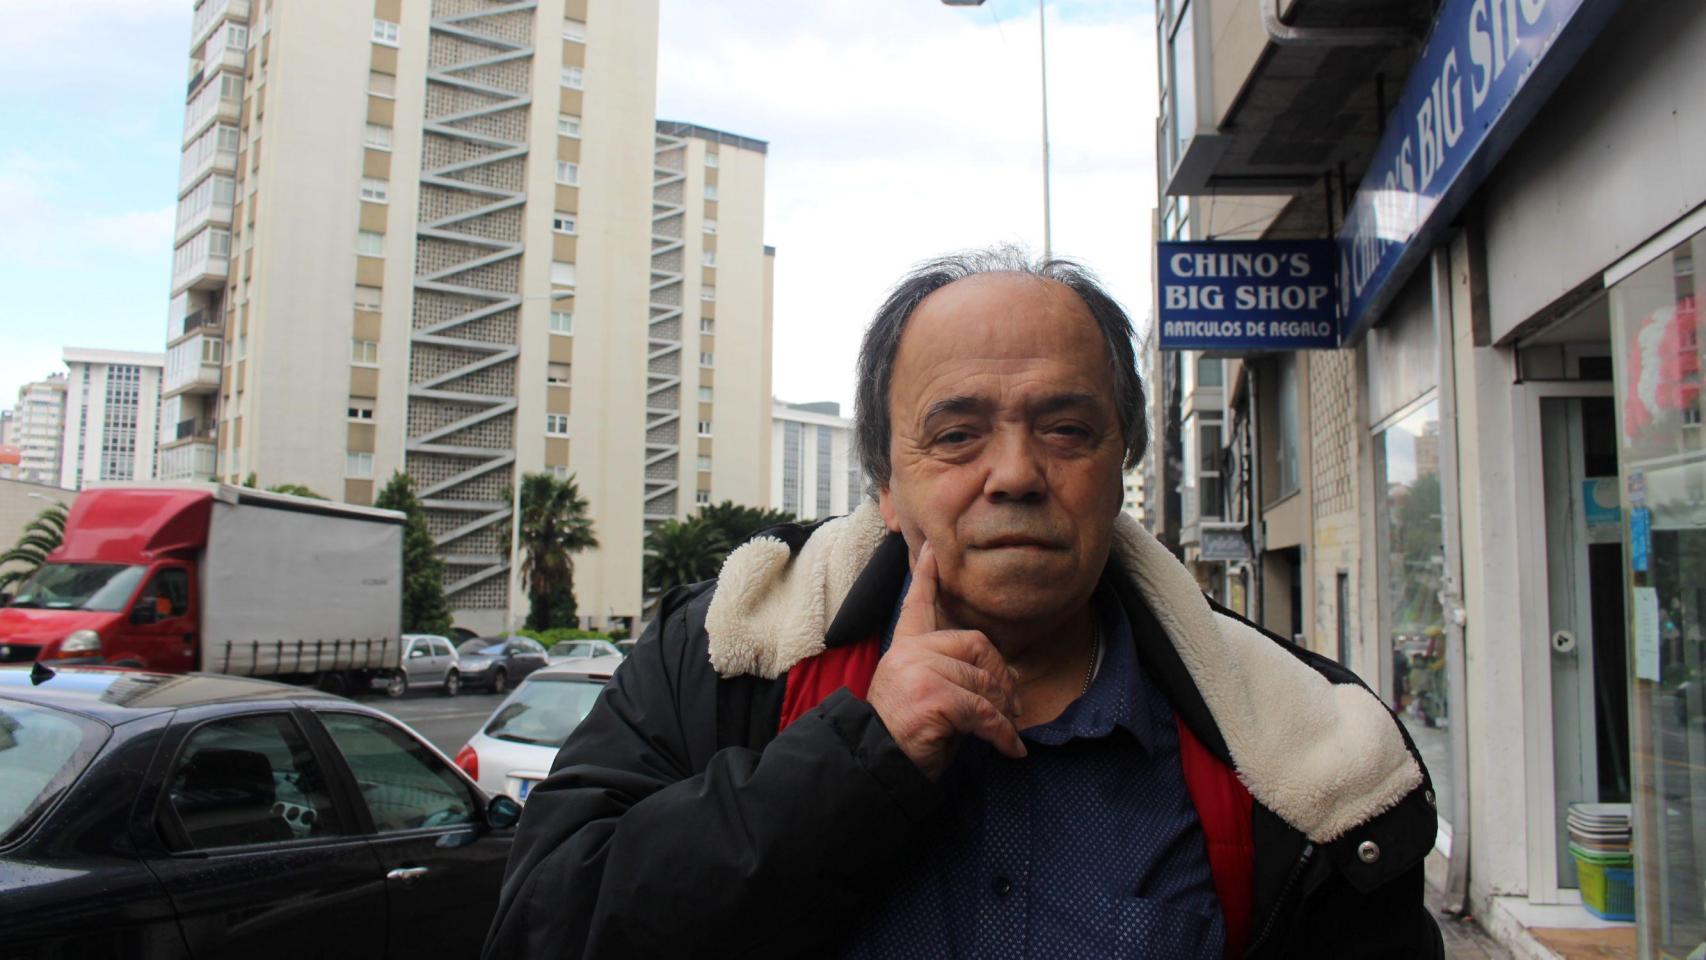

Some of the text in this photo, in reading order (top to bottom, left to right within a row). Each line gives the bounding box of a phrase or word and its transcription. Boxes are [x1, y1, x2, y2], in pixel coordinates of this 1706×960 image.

[1416, 45, 1465, 194] BIG
[1170, 252, 1311, 278] CHINO'S
[1165, 285, 1329, 310] BIG SHOP
[1164, 320, 1331, 337] ARTICULOS DE REGALO
